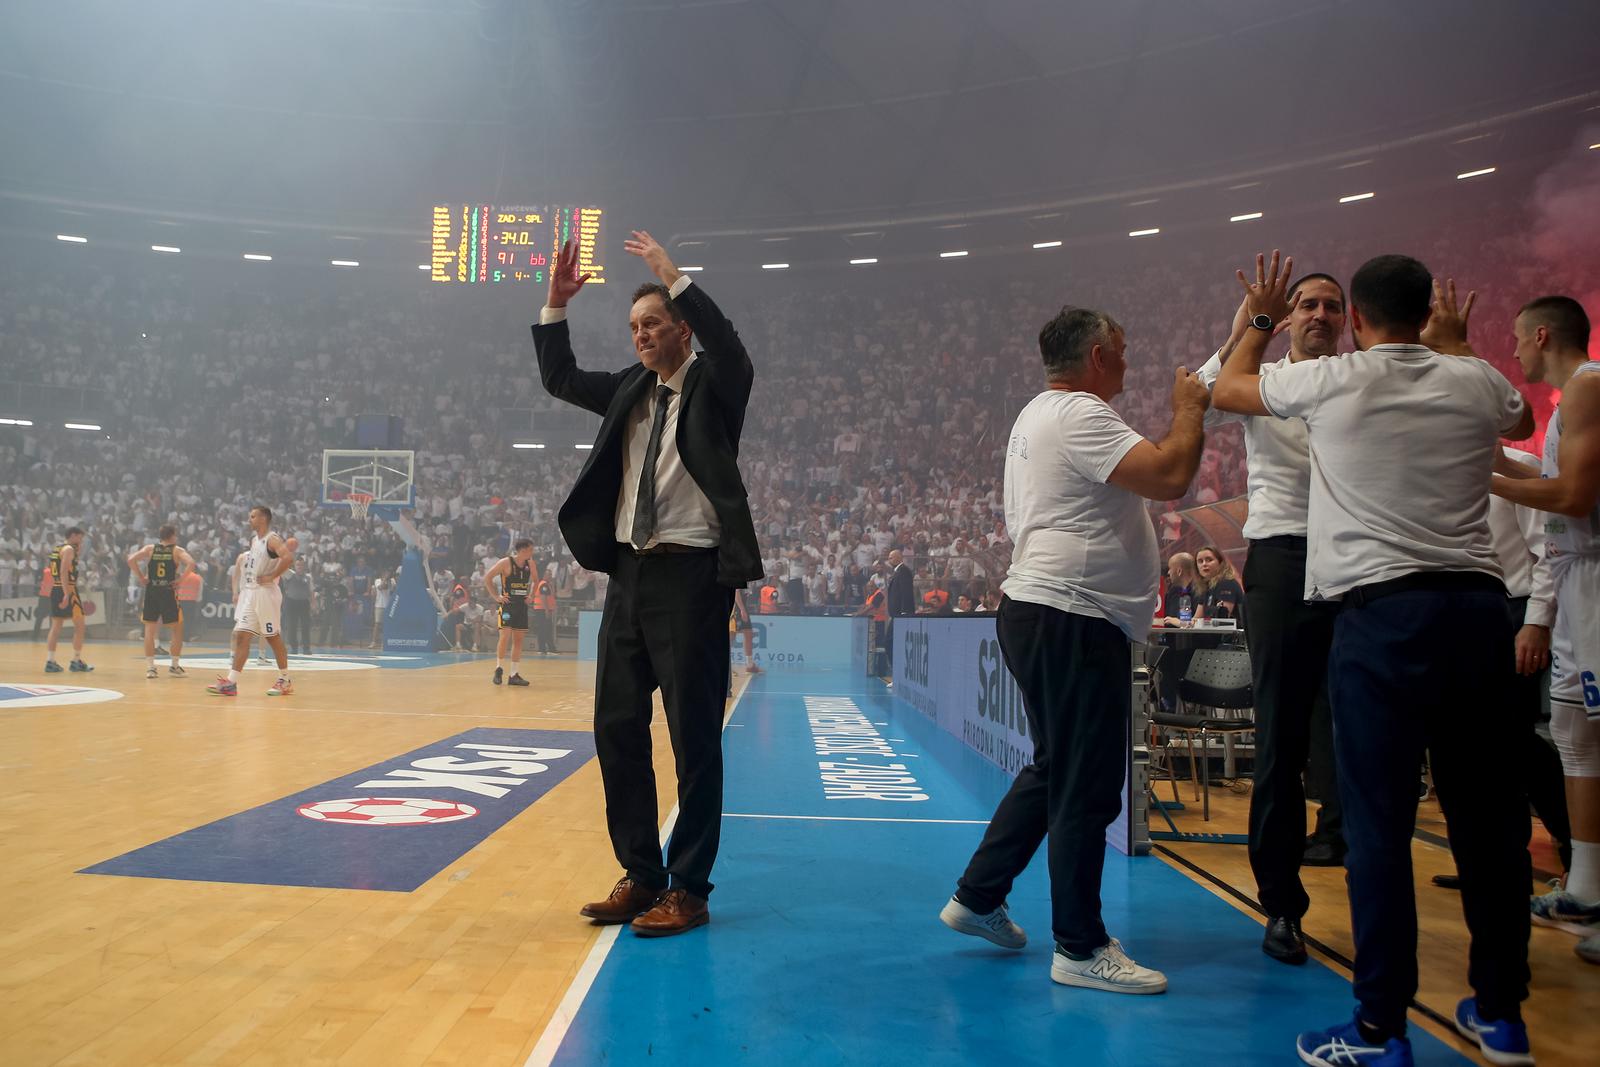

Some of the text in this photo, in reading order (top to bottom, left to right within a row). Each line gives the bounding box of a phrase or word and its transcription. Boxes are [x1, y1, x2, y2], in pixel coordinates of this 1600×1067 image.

[497, 214, 516, 223] ZAD
[525, 214, 543, 223] SPL
[498, 252, 514, 265] 91
[493, 270, 501, 282] 5
[515, 271, 522, 281] 4
[535, 271, 543, 282] 5
[157, 561, 166, 577] 6
[266, 622, 273, 633] 6
[768, 653, 805, 662] VODA
[904, 620, 929, 688] santa
[1580, 670, 1600, 708] 6
[814, 736, 918, 757] ĆOSIĆ
[963, 719, 994, 759] PRIRODNA
[354, 743, 574, 799] PSK
[818, 761, 930, 802] ZADAR
[1090, 957, 1121, 981] N
